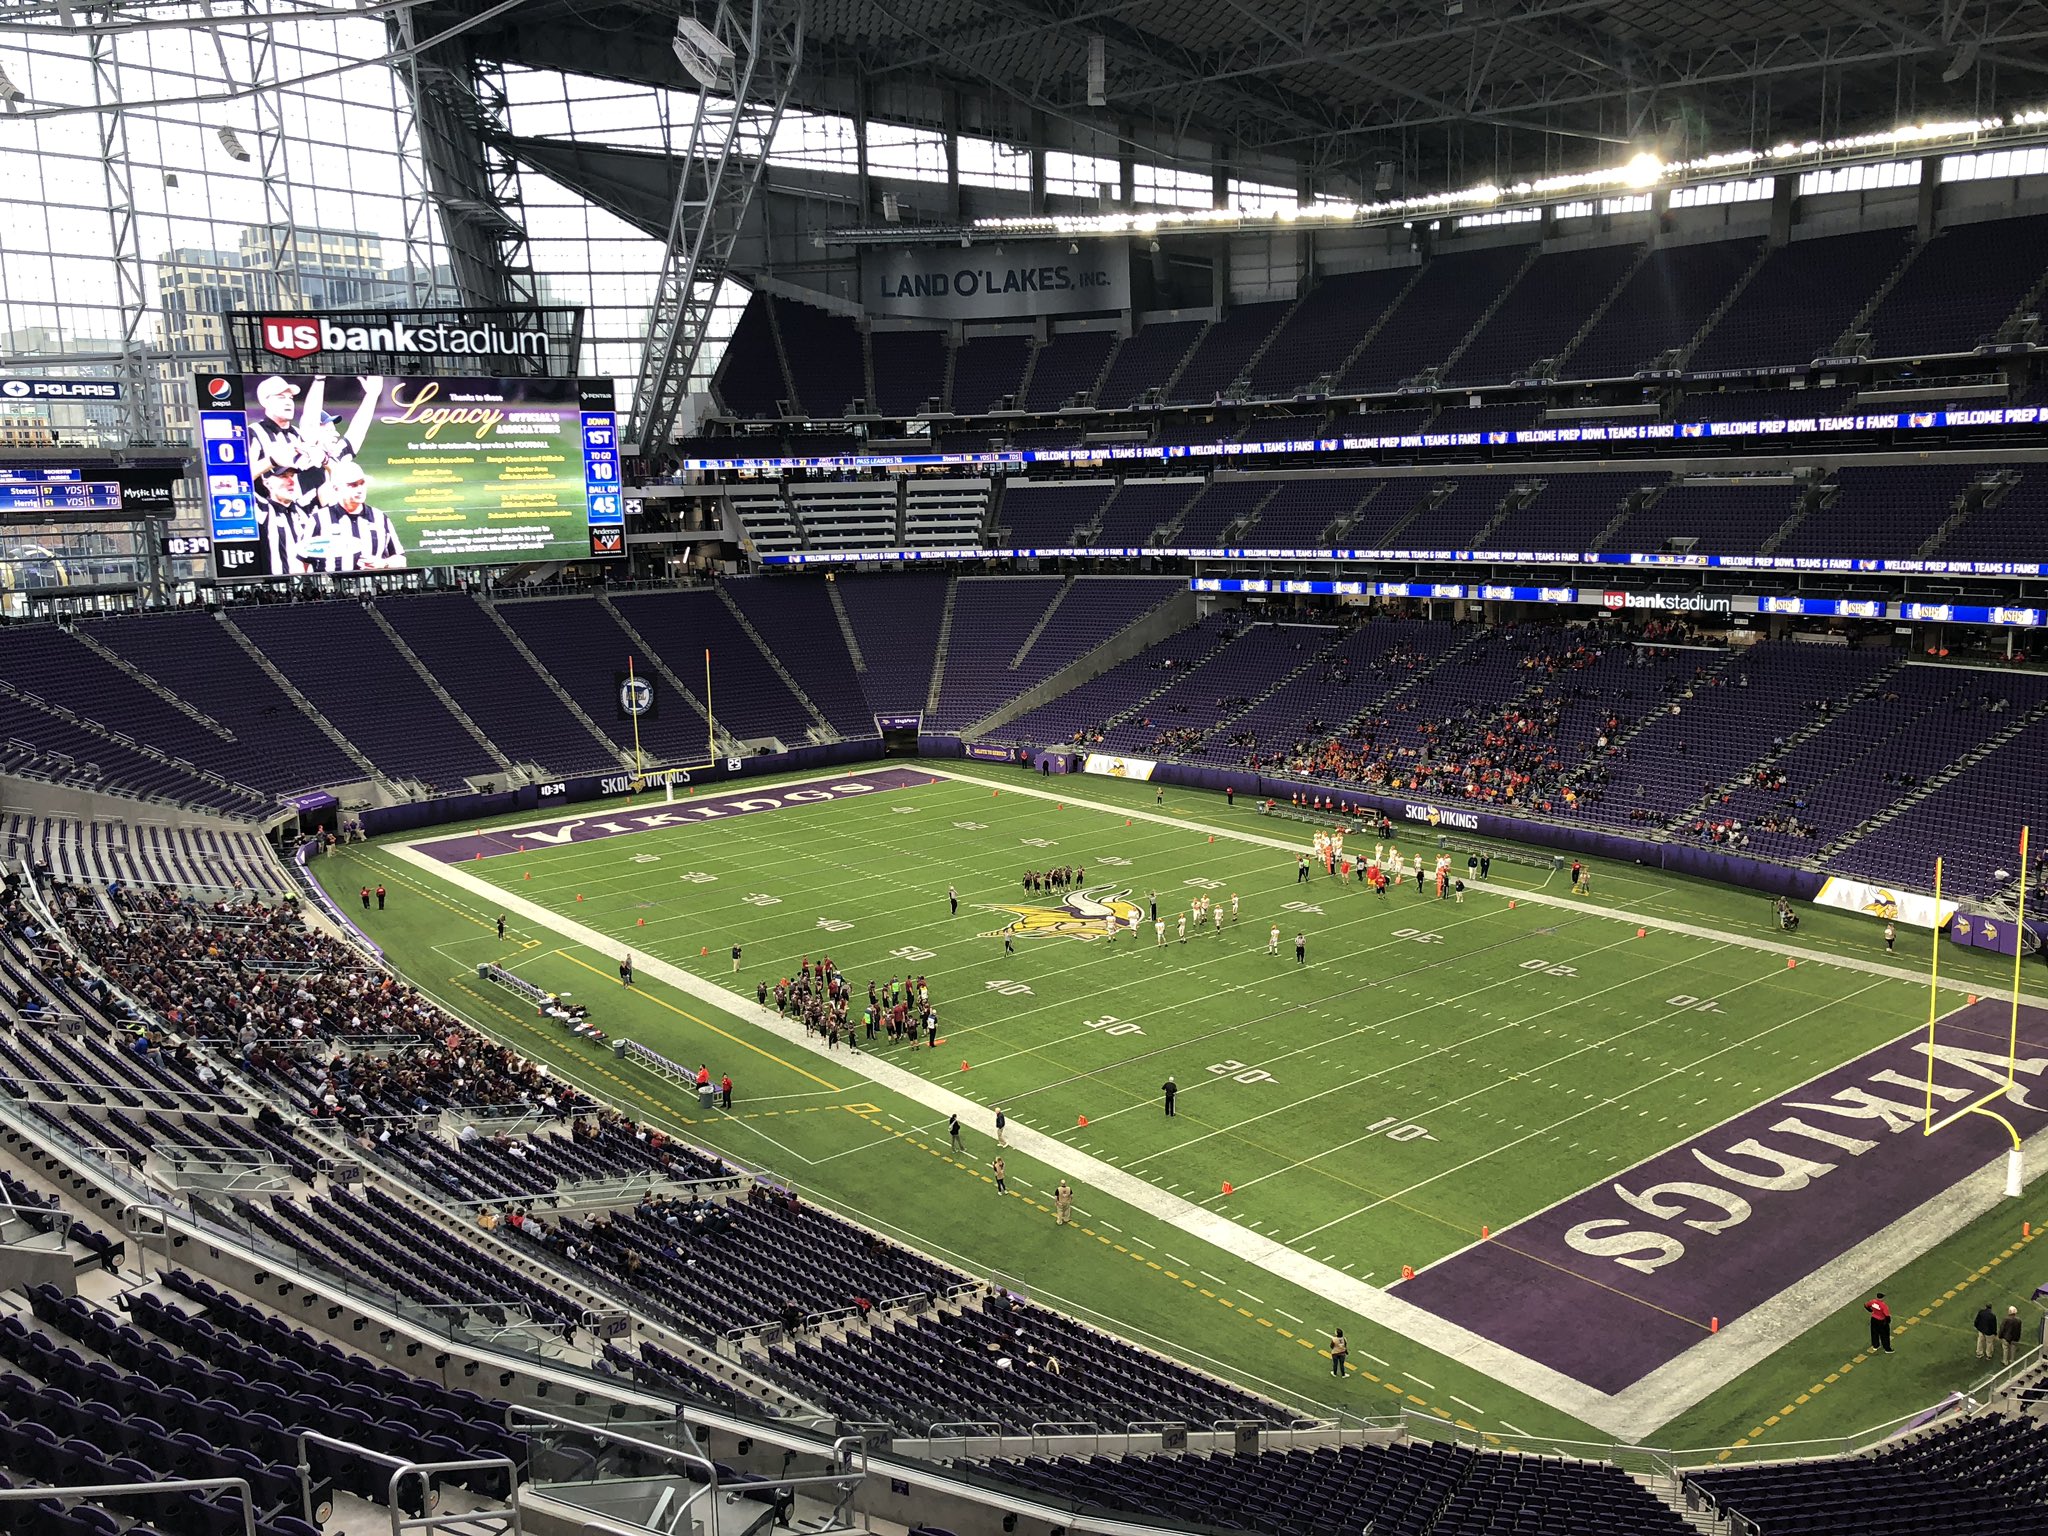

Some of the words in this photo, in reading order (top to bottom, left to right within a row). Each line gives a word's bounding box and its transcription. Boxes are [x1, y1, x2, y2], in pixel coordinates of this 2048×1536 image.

[881, 274, 948, 298] LAND
[1080, 272, 1111, 288] INC.
[34, 382, 116, 396] POLARIS
[381, 382, 504, 440] Legacy
[1946, 411, 2002, 425] WELCOME
[2005, 408, 2037, 422] PREP
[1712, 422, 1758, 435] WELCOME
[1759, 420, 1786, 433] PREP
[1787, 419, 1817, 432] BOWL
[1818, 417, 1854, 430] TEAMS
[1855, 416, 1865, 429] &
[588, 431, 611, 444] 1ST
[1343, 438, 1379, 449] WELCOME
[1380, 437, 1400, 448] PREP
[1401, 436, 1423, 447] BOWL
[1424, 435, 1449, 446] TEAMS
[1450, 434, 1457, 445] &
[1517, 430, 1557, 442] WELCOME
[1558, 429, 1580, 441] PREP
[1581, 428, 1606, 440] BOWL
[1607, 427, 1637, 439] TEAMS
[1638, 426, 1646, 437] &
[218, 443, 234, 462] 0
[1035, 451, 1069, 460] WELCOME
[1070, 450, 1089, 459] PREP
[1090, 450, 1111, 459] BOWL
[1112, 449, 1135, 458] TEAMS
[1136, 449, 1142, 457] &
[1190, 445, 1223, 456] WELCOME
[1224, 444, 1241, 454] PREP
[1242, 444, 1262, 454] BOWL
[1263, 443, 1286, 453] TEAMS
[1287, 442, 1293, 452] &
[592, 463, 612, 480] 10
[65, 486, 82, 495] YDS
[105, 485, 116, 494] TD
[67, 498, 83, 507] YDS
[106, 497, 117, 505] TD
[218, 499, 246, 518] 29
[593, 497, 615, 514] 45
[625, 500, 641, 513] 25
[169, 539, 209, 554] 10:39
[222, 549, 254, 569] Lite
[1561, 553, 1578, 561] FANS!
[1720, 557, 1753, 566] WELCOME
[1754, 558, 1773, 567] PREP
[1774, 558, 1795, 567] BOWL
[1796, 559, 1821, 568] TEAMS
[1829, 560, 1851, 568] FANS!
[1884, 561, 1923, 570] WELCOME
[1924, 562, 1947, 571] PREP
[1948, 562, 1973, 572] BOWL
[1974, 563, 2003, 573] TEAMS
[2013, 564, 2039, 574] FANS!
[728, 759, 740, 769] 25
[541, 784, 565, 796] 10:39
[601, 778, 632, 794] SKOL
[645, 770, 690, 788] VIKINGS
[512, 782, 874, 844] VIKINGS
[1406, 804, 1428, 821] SKOL
[1440, 810, 1478, 829] VIKINGS
[816, 917, 854, 931] 40
[889, 946, 937, 961] 50
[985, 980, 1028, 996] 40
[1084, 1015, 1139, 1036] 30
[1206, 1060, 1273, 1084] 20
[1366, 1117, 1430, 1142] 10
[1564, 1042, 2048, 1275] VIKINGS
[340, 1167, 360, 1181] 128
[607, 1318, 627, 1335] 126
